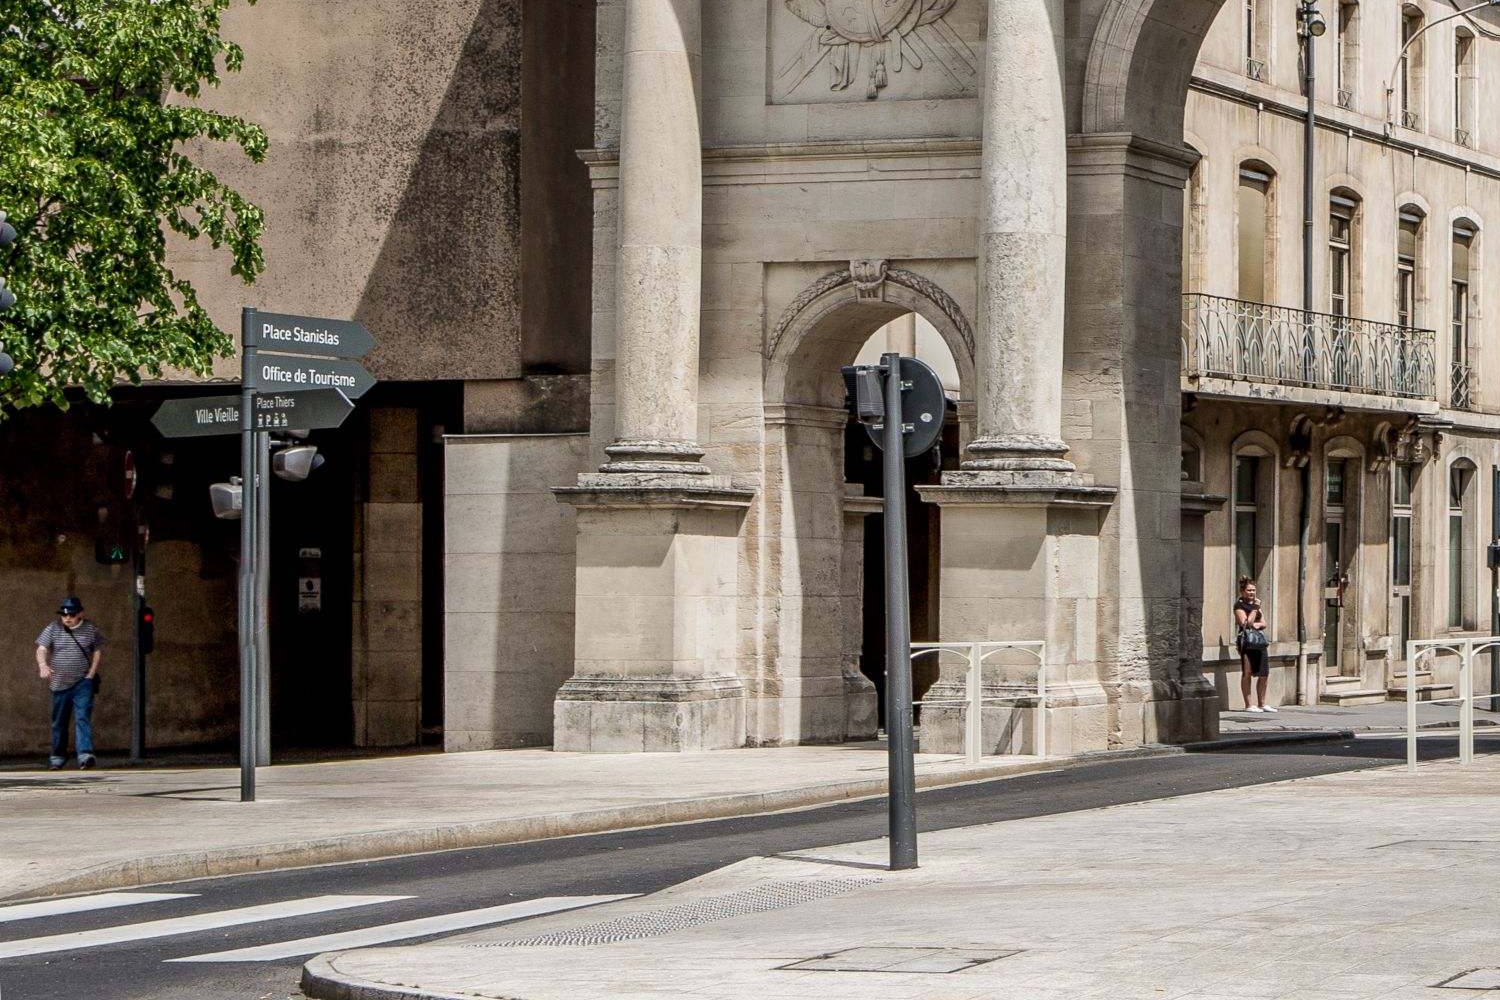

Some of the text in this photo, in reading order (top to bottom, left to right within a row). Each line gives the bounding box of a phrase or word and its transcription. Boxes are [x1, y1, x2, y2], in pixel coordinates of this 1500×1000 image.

[262, 324, 339, 346] Place Stanislas
[262, 366, 355, 387] Office de Tourisme
[256, 396, 295, 409] Place Thiers
[195, 407, 239, 424] Ville Vieille
